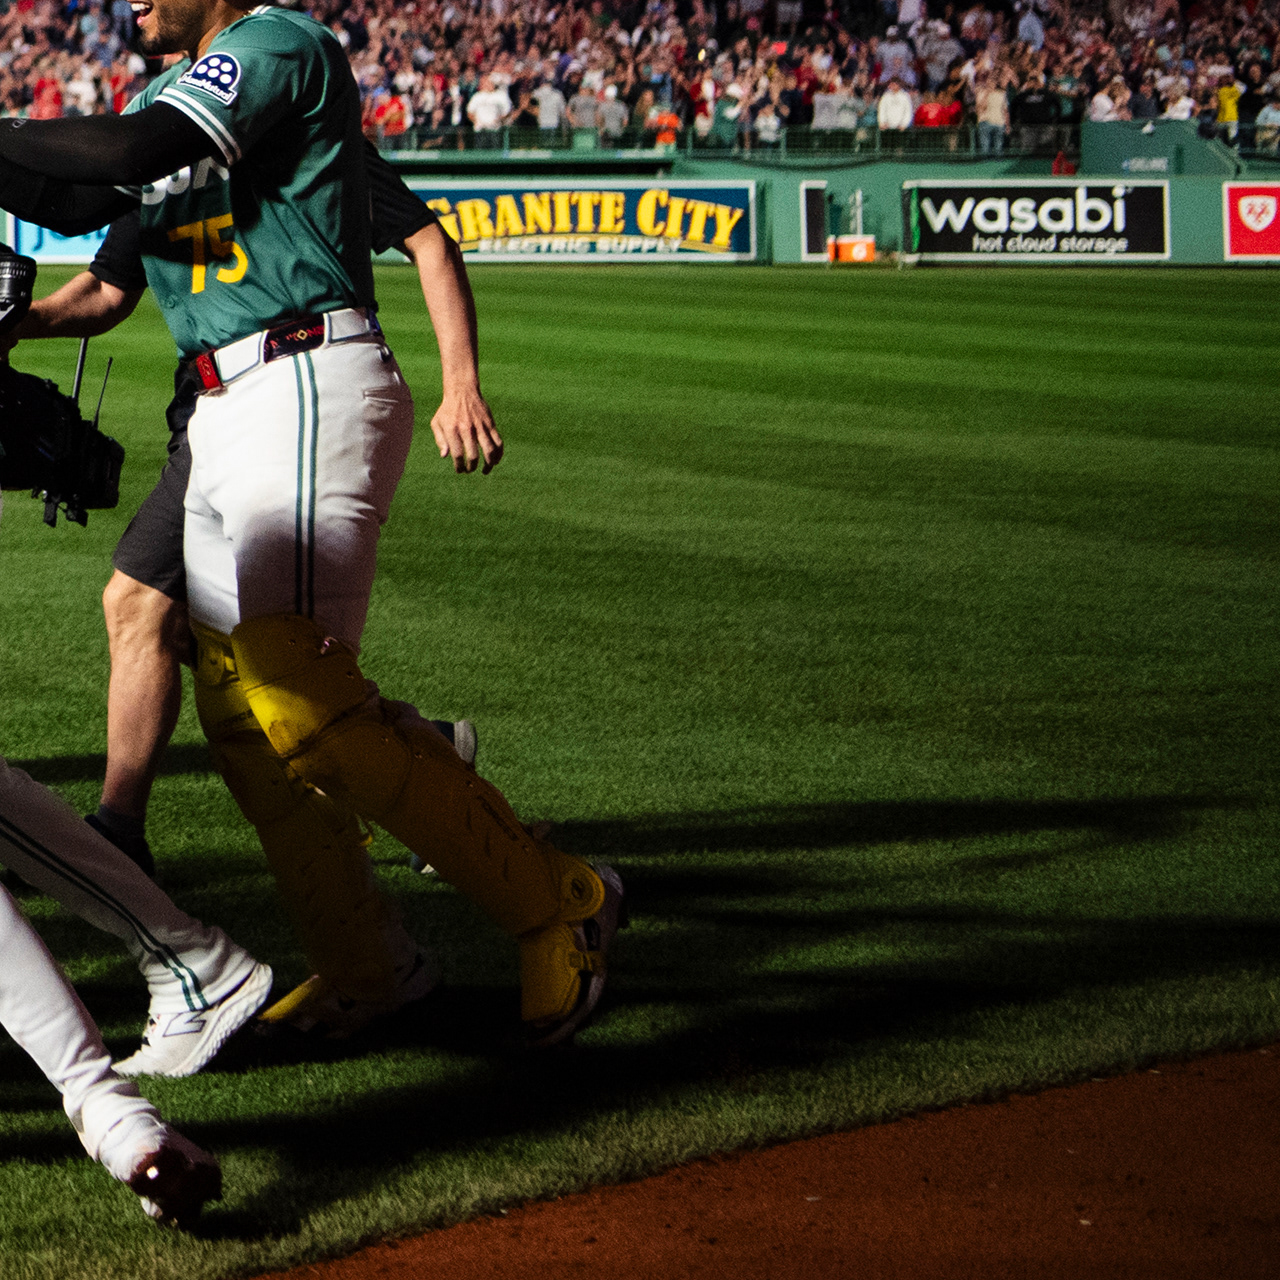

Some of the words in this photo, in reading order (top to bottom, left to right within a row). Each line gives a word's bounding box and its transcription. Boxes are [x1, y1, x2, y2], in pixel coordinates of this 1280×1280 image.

[426, 190, 627, 243] GRANITE
[637, 188, 744, 248] CITY
[921, 184, 1126, 233] wasabi
[167, 213, 248, 294] 75
[478, 237, 591, 253] ELECTRIC
[596, 236, 683, 253] SUPPLY
[973, 233, 1003, 252] hot
[1006, 233, 1057, 252] cloud
[1060, 235, 1129, 256] storage
